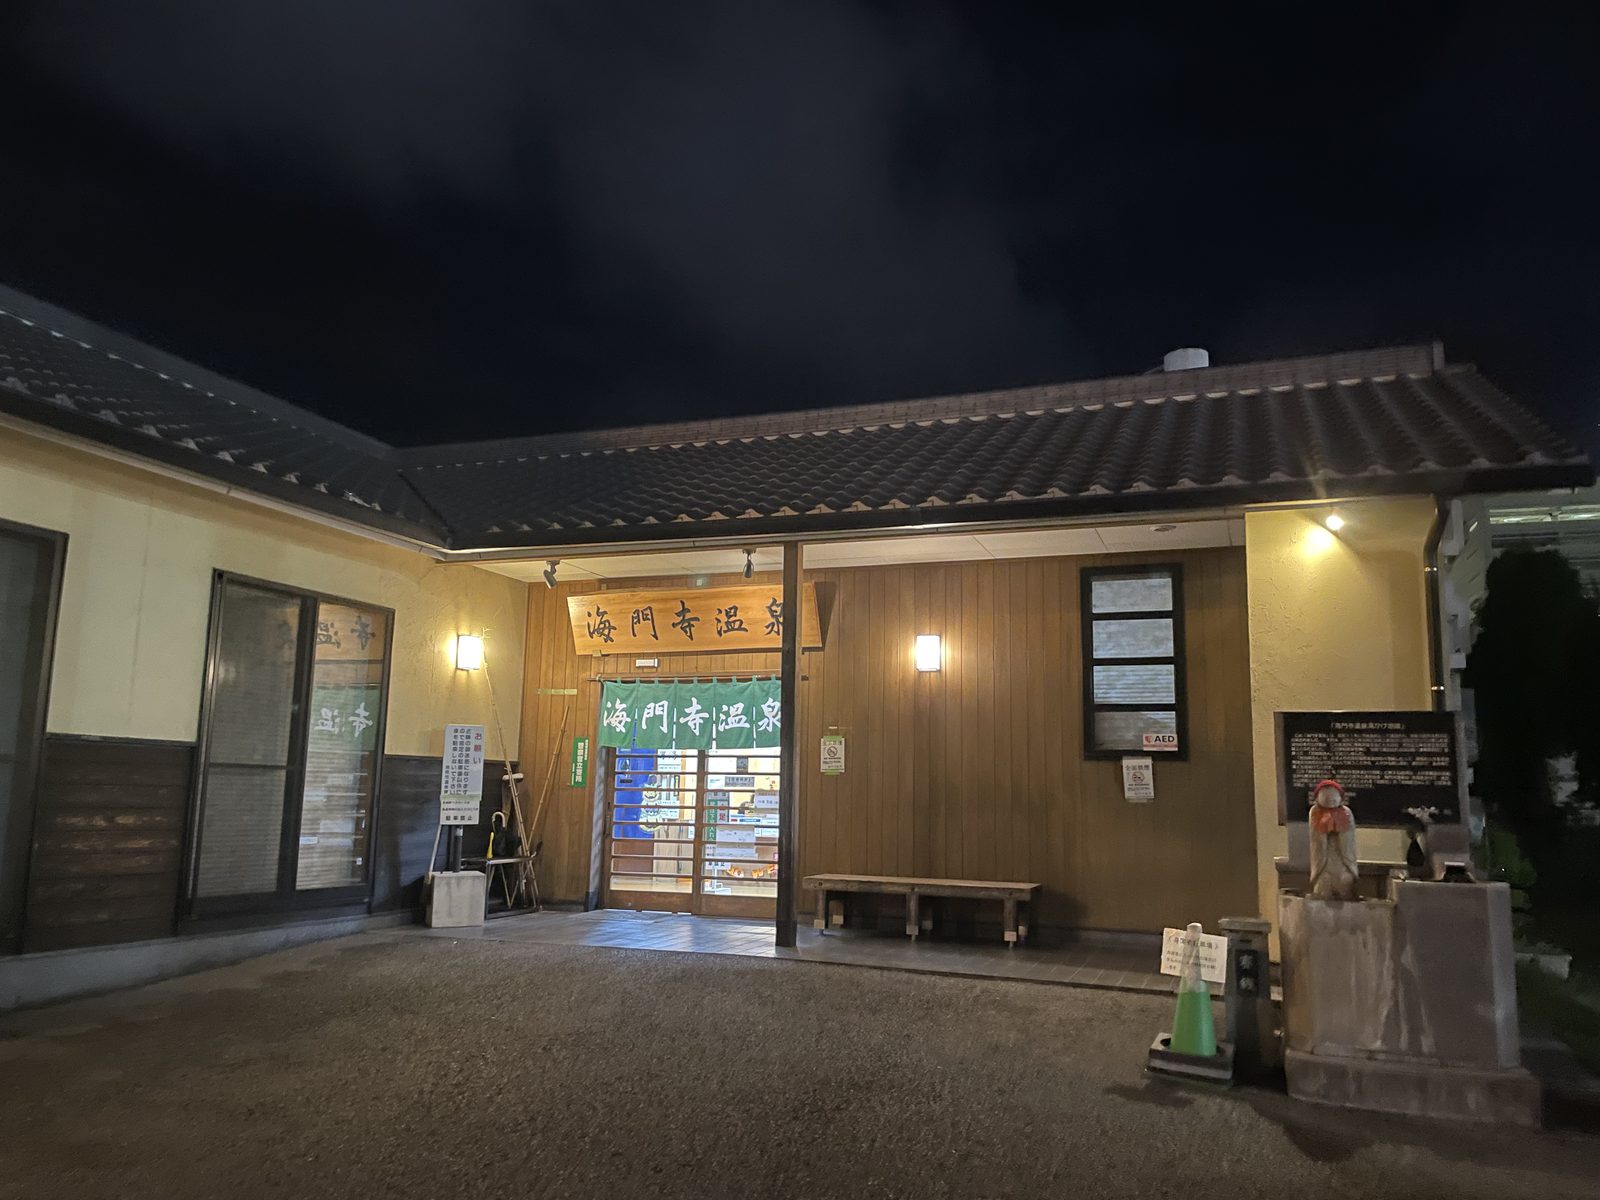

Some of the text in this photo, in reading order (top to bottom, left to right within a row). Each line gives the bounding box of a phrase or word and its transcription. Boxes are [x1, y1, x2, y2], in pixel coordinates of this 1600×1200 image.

[587, 597, 783, 643] 海門寺温泉
[603, 697, 781, 736] 海門寺温泉
[1154, 735, 1175, 743] AED
